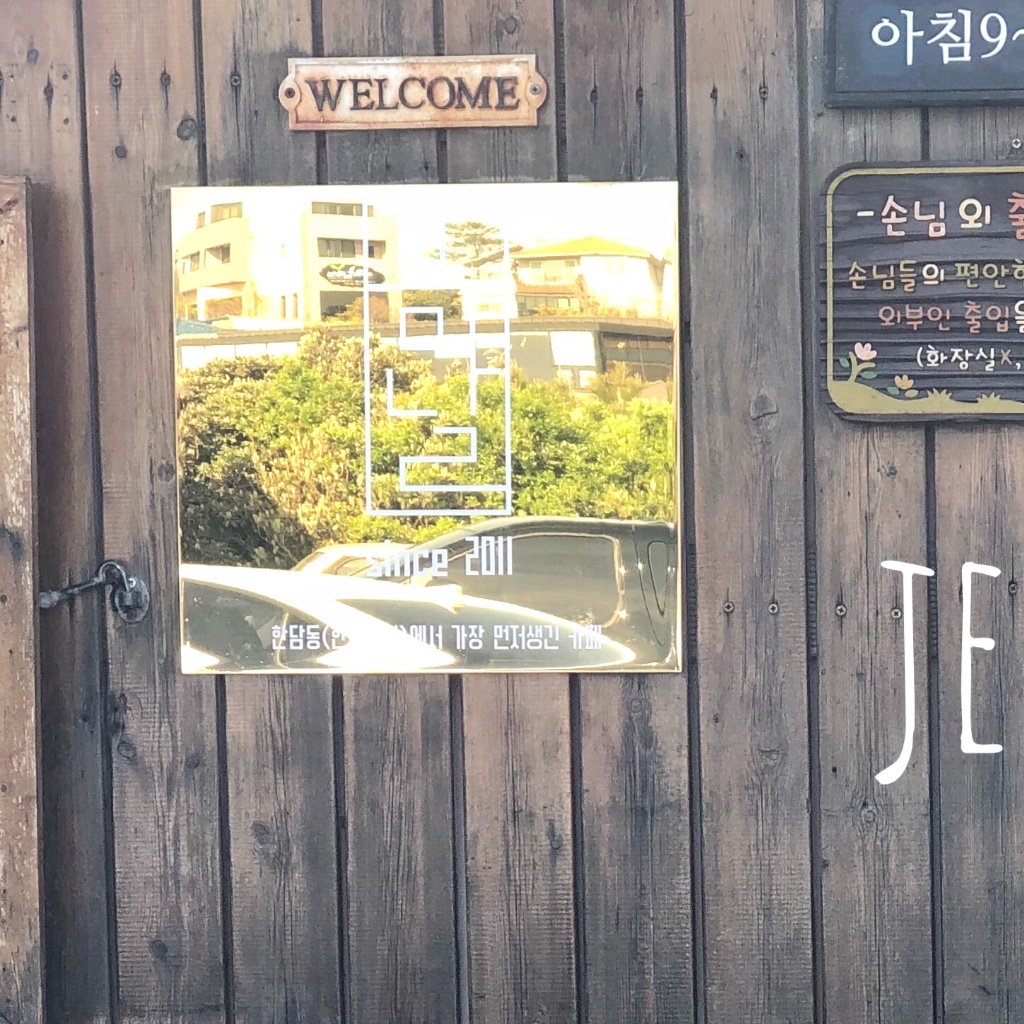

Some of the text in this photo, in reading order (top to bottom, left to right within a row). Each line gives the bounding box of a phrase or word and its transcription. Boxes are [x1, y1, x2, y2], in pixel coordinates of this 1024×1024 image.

[305, 75, 521, 112] WELCOME
[958, 198, 991, 229] 외
[848, 260, 944, 292] 손님들의
[878, 303, 950, 331] 외부인
[366, 535, 513, 577] since 2011
[451, 624, 485, 650] 가장
